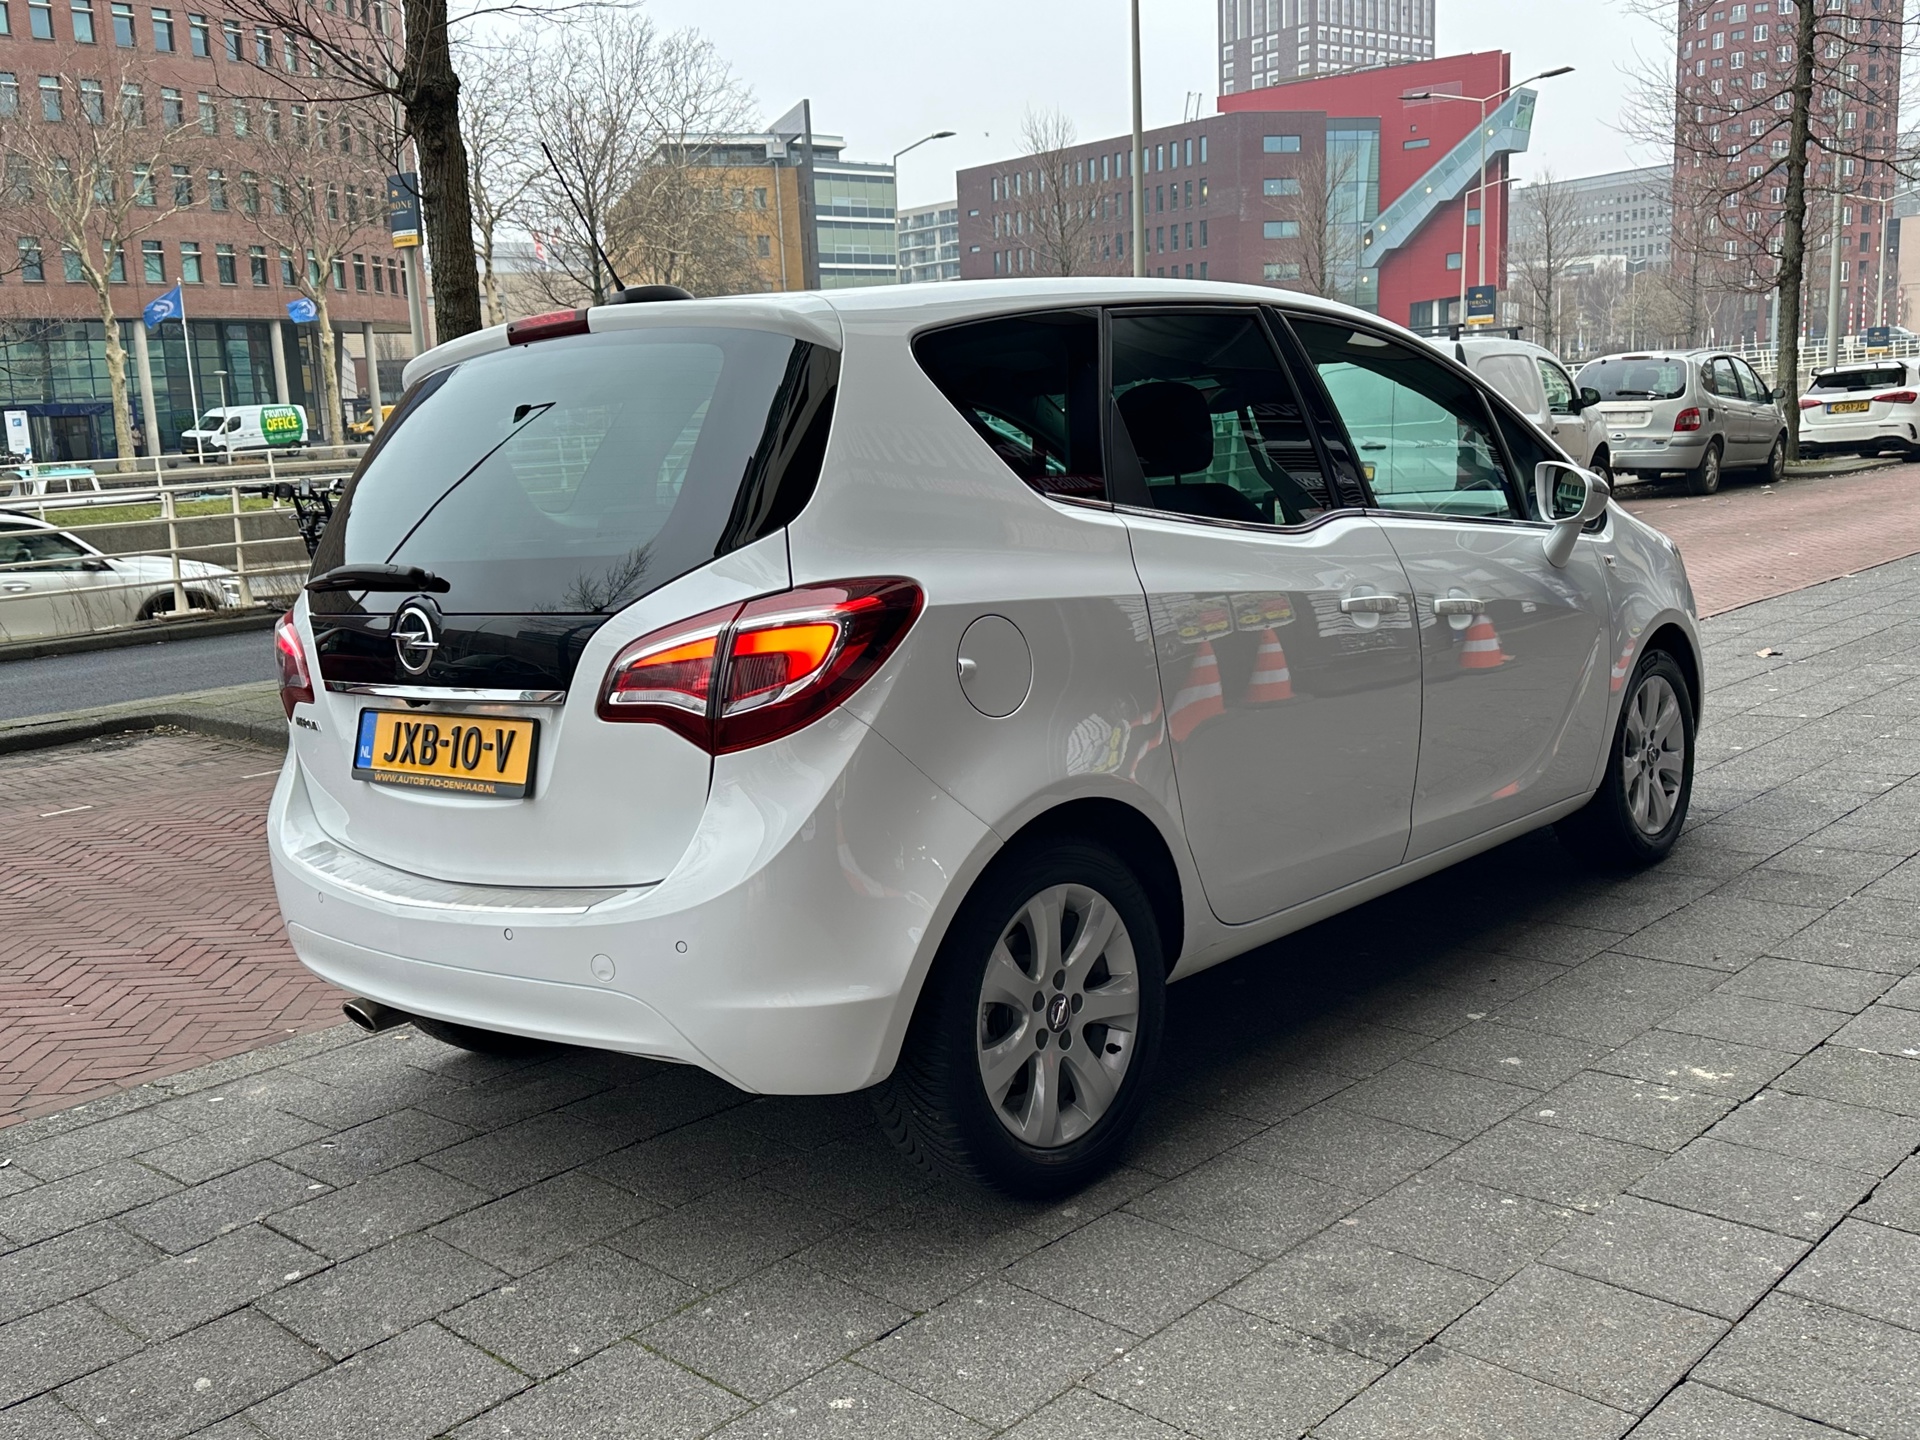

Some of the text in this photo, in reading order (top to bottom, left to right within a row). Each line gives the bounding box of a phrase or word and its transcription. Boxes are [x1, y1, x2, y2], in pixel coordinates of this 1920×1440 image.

[263, 407, 296, 419] FRUITFUL
[266, 416, 298, 431] OFFICE
[360, 746, 371, 759] NL
[383, 721, 517, 773] JXB-10-V
[374, 773, 496, 794] WWW.AUTOSTAD-DENHAAG.NL
